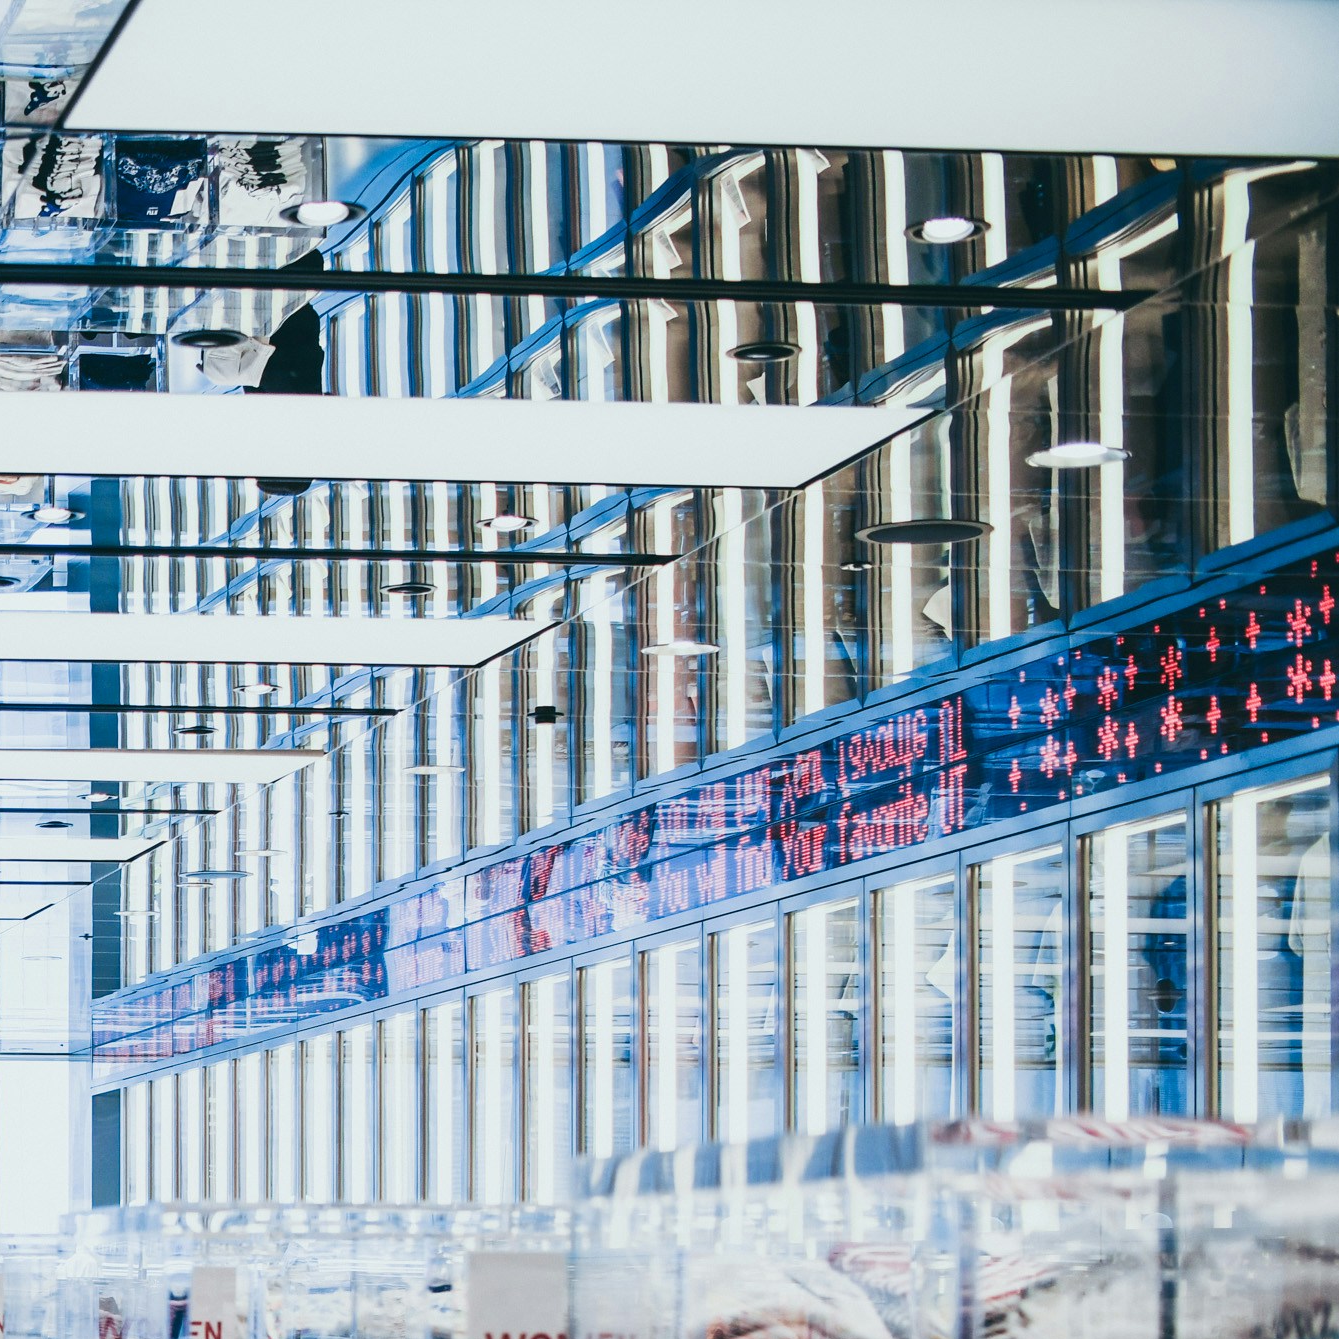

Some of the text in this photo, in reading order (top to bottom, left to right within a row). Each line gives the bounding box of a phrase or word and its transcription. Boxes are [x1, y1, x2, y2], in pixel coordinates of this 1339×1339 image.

[735, 826, 772, 894] find
[838, 782, 929, 865] favorite
[939, 764, 968, 834] UT
